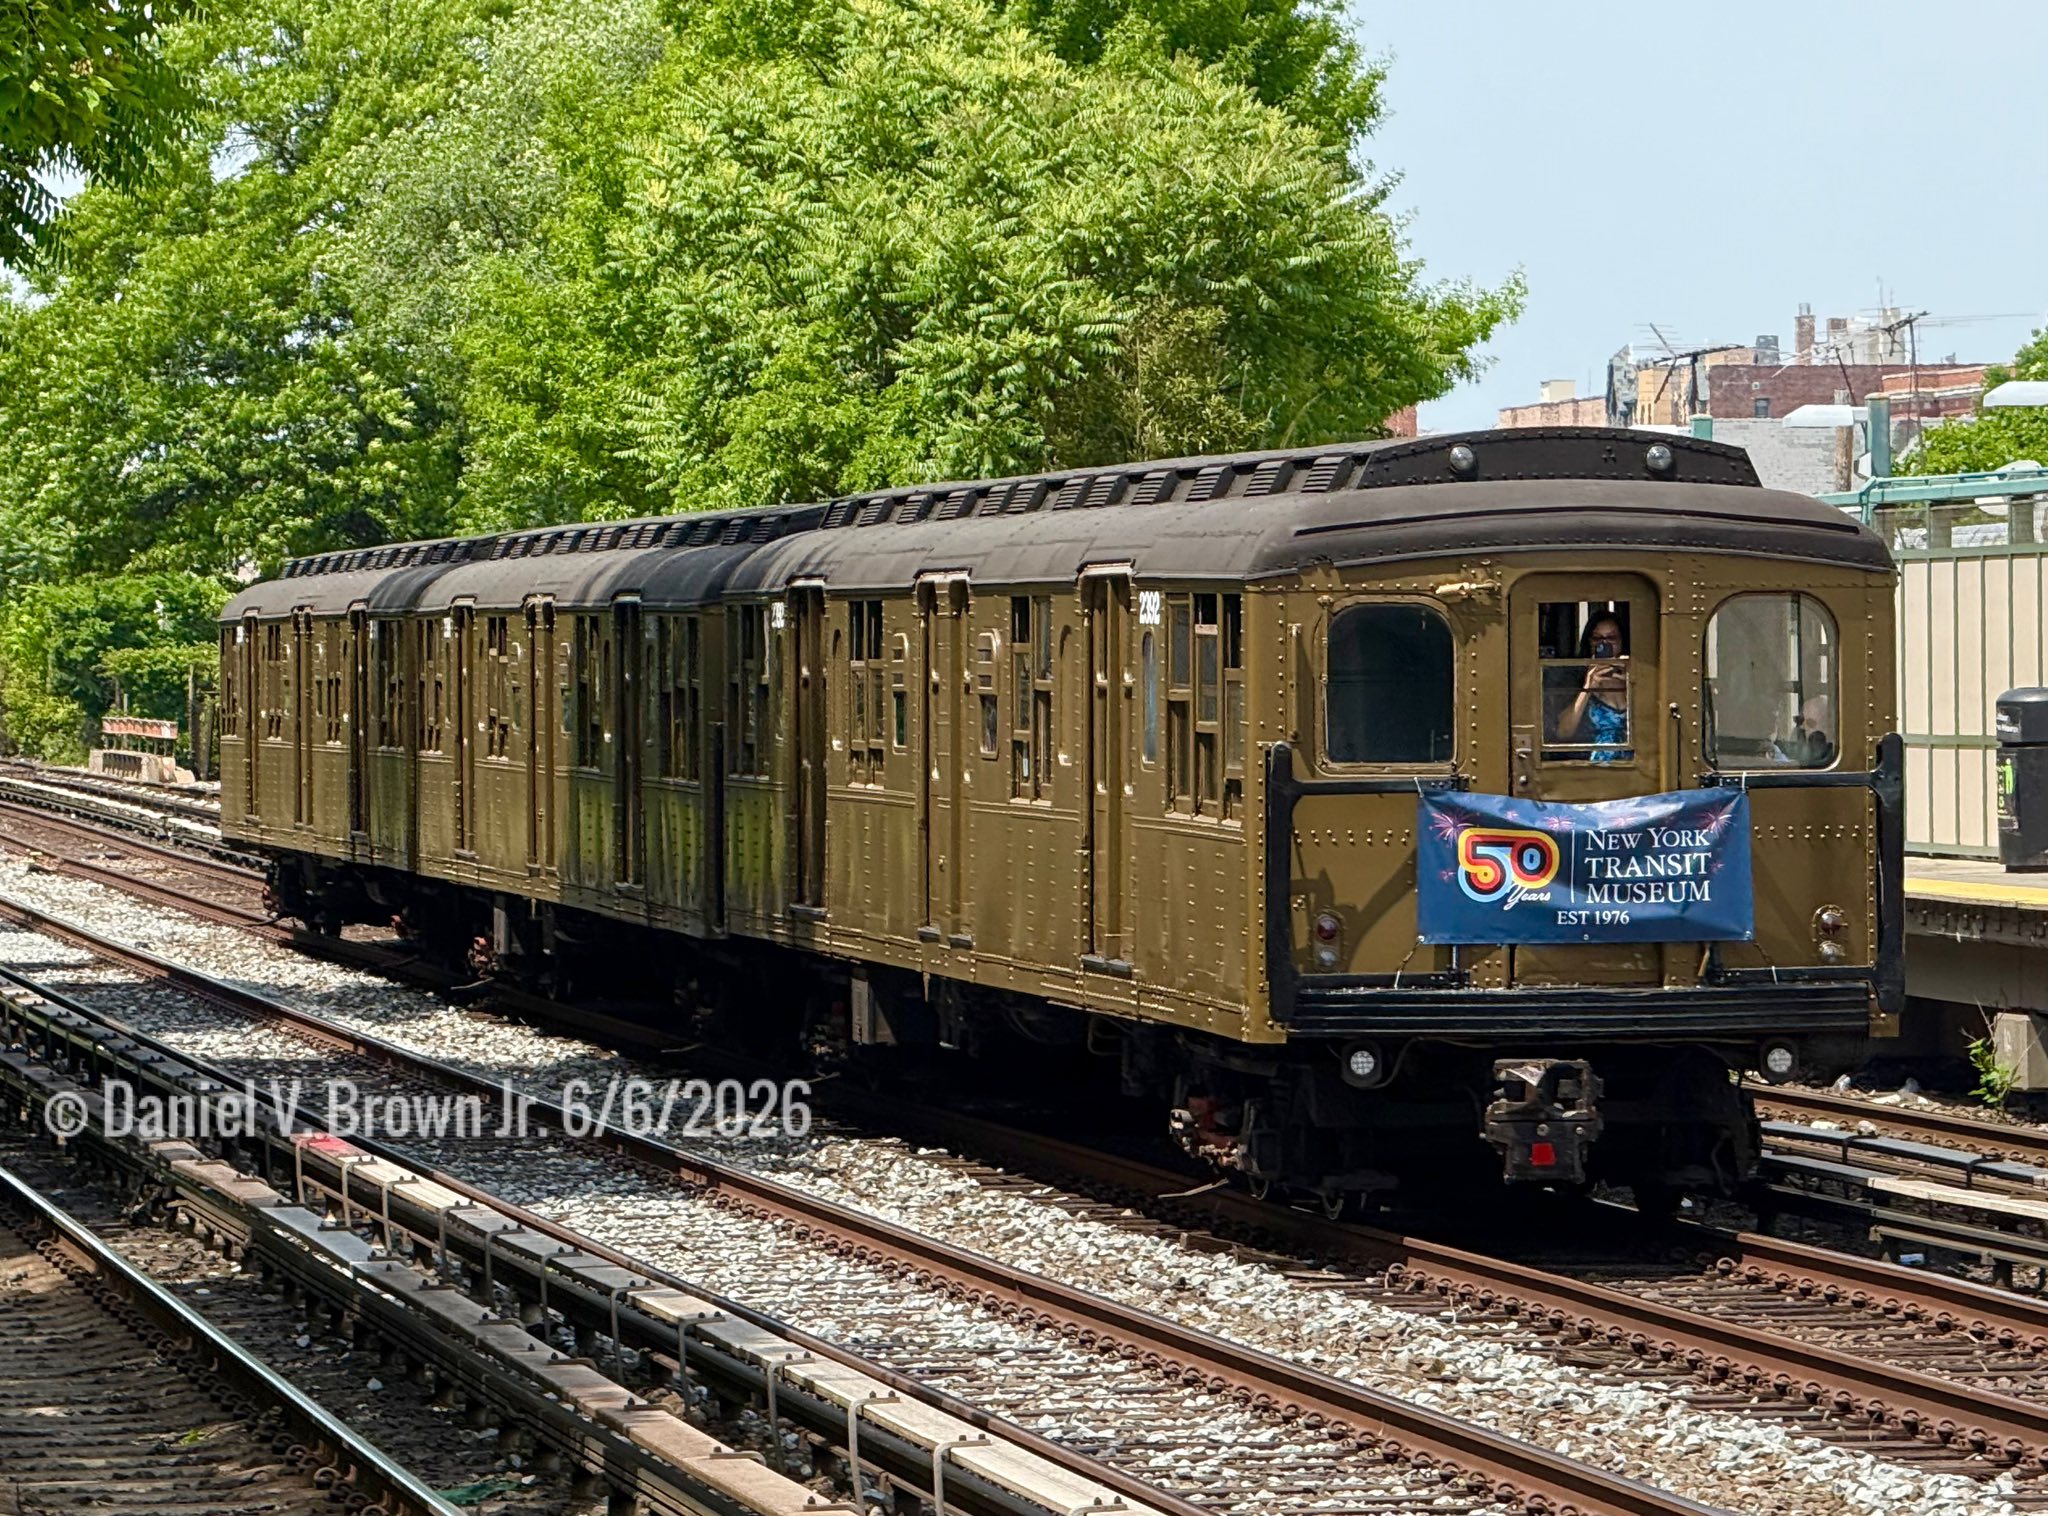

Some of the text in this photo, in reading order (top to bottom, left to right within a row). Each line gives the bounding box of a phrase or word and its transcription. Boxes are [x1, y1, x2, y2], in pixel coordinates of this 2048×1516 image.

[1139, 591, 1160, 625] 2392
[1585, 826, 1711, 851] NEW YORK
[1457, 828, 1560, 903] 50
[1584, 852, 1712, 879] TRANSIT
[1503, 882, 1551, 911] Years
[1585, 880, 1712, 904] MUSEUM
[1557, 910, 1630, 925] EST 1976
